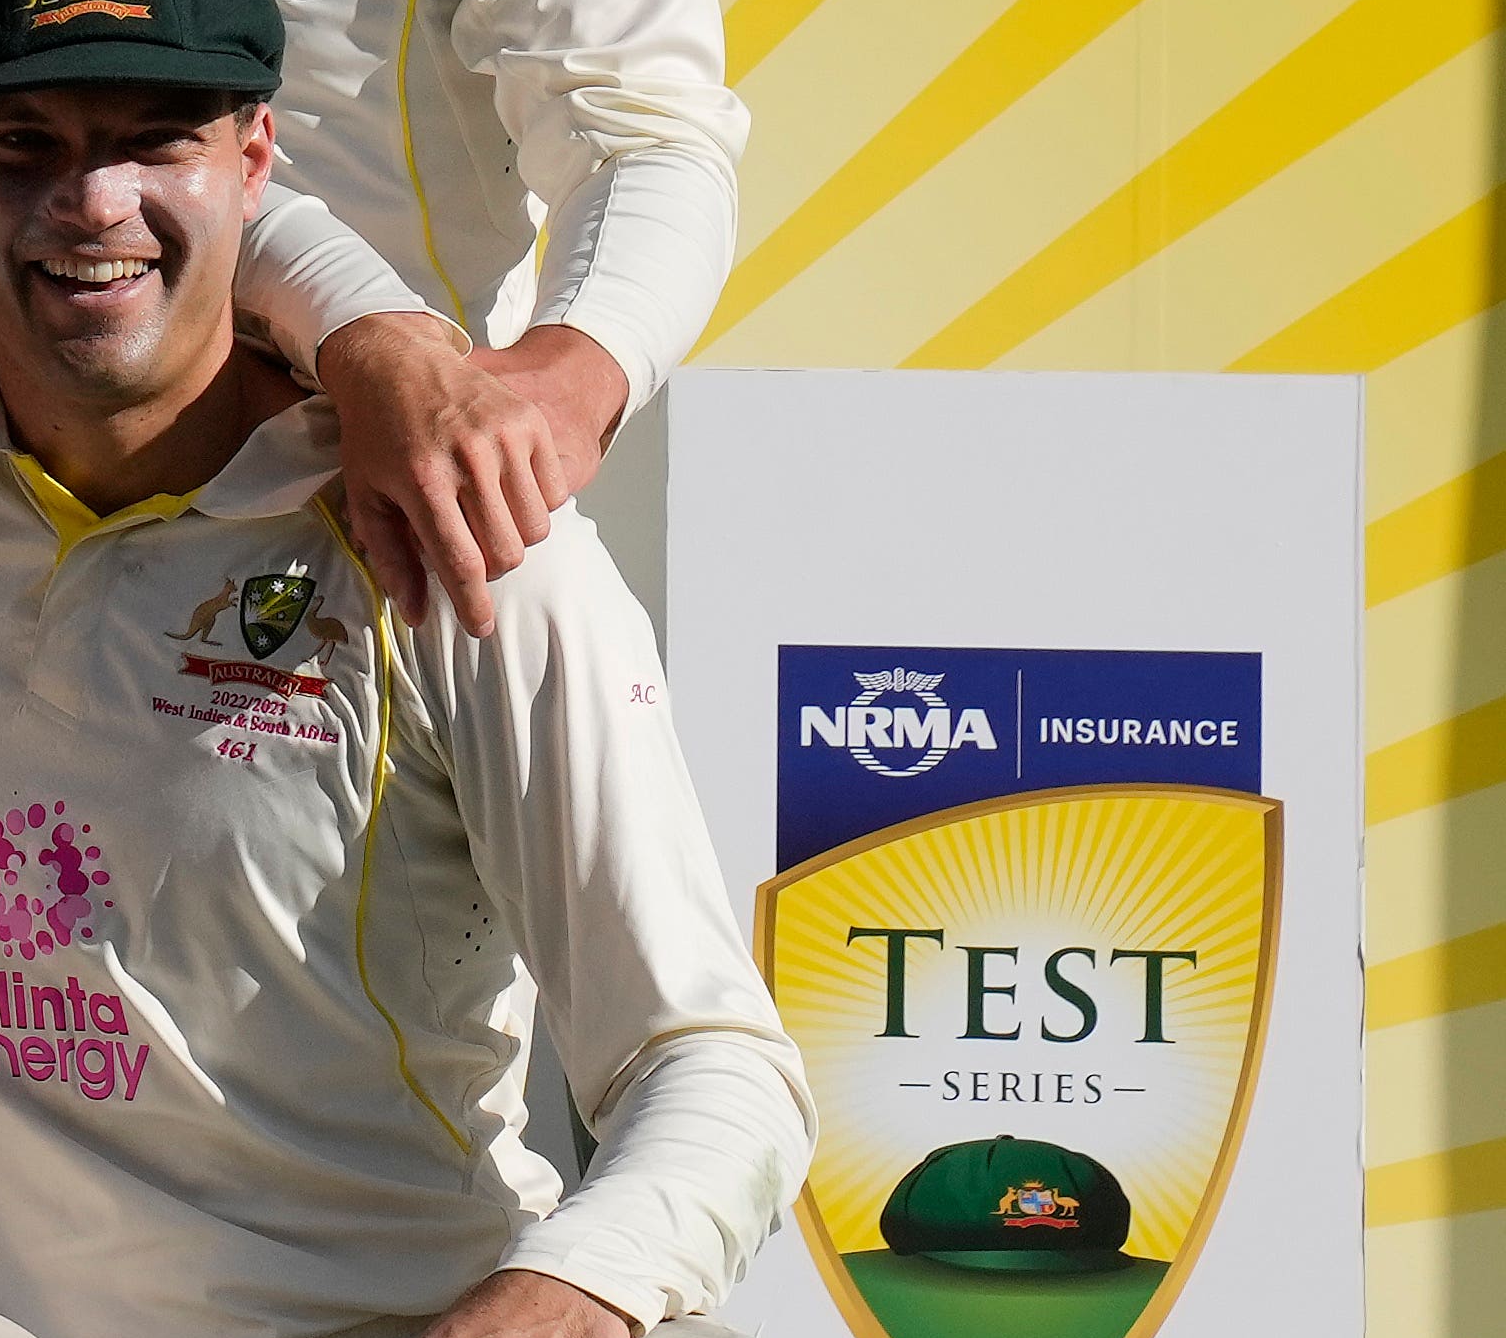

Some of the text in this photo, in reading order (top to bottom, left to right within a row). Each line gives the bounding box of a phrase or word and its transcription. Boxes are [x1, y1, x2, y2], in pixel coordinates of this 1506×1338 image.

[212, 664, 301, 702] AUSTRALIA
[630, 683, 656, 705] AC
[151, 696, 342, 744] West Indies & South Africa
[210, 689, 288, 717] 2022/2023
[799, 704, 998, 751] NRMA
[1038, 716, 1239, 747] INSURANCE
[216, 738, 259, 763] 461
[844, 925, 1199, 1045] TEST
[941, 1069, 1105, 1106] SERIES
